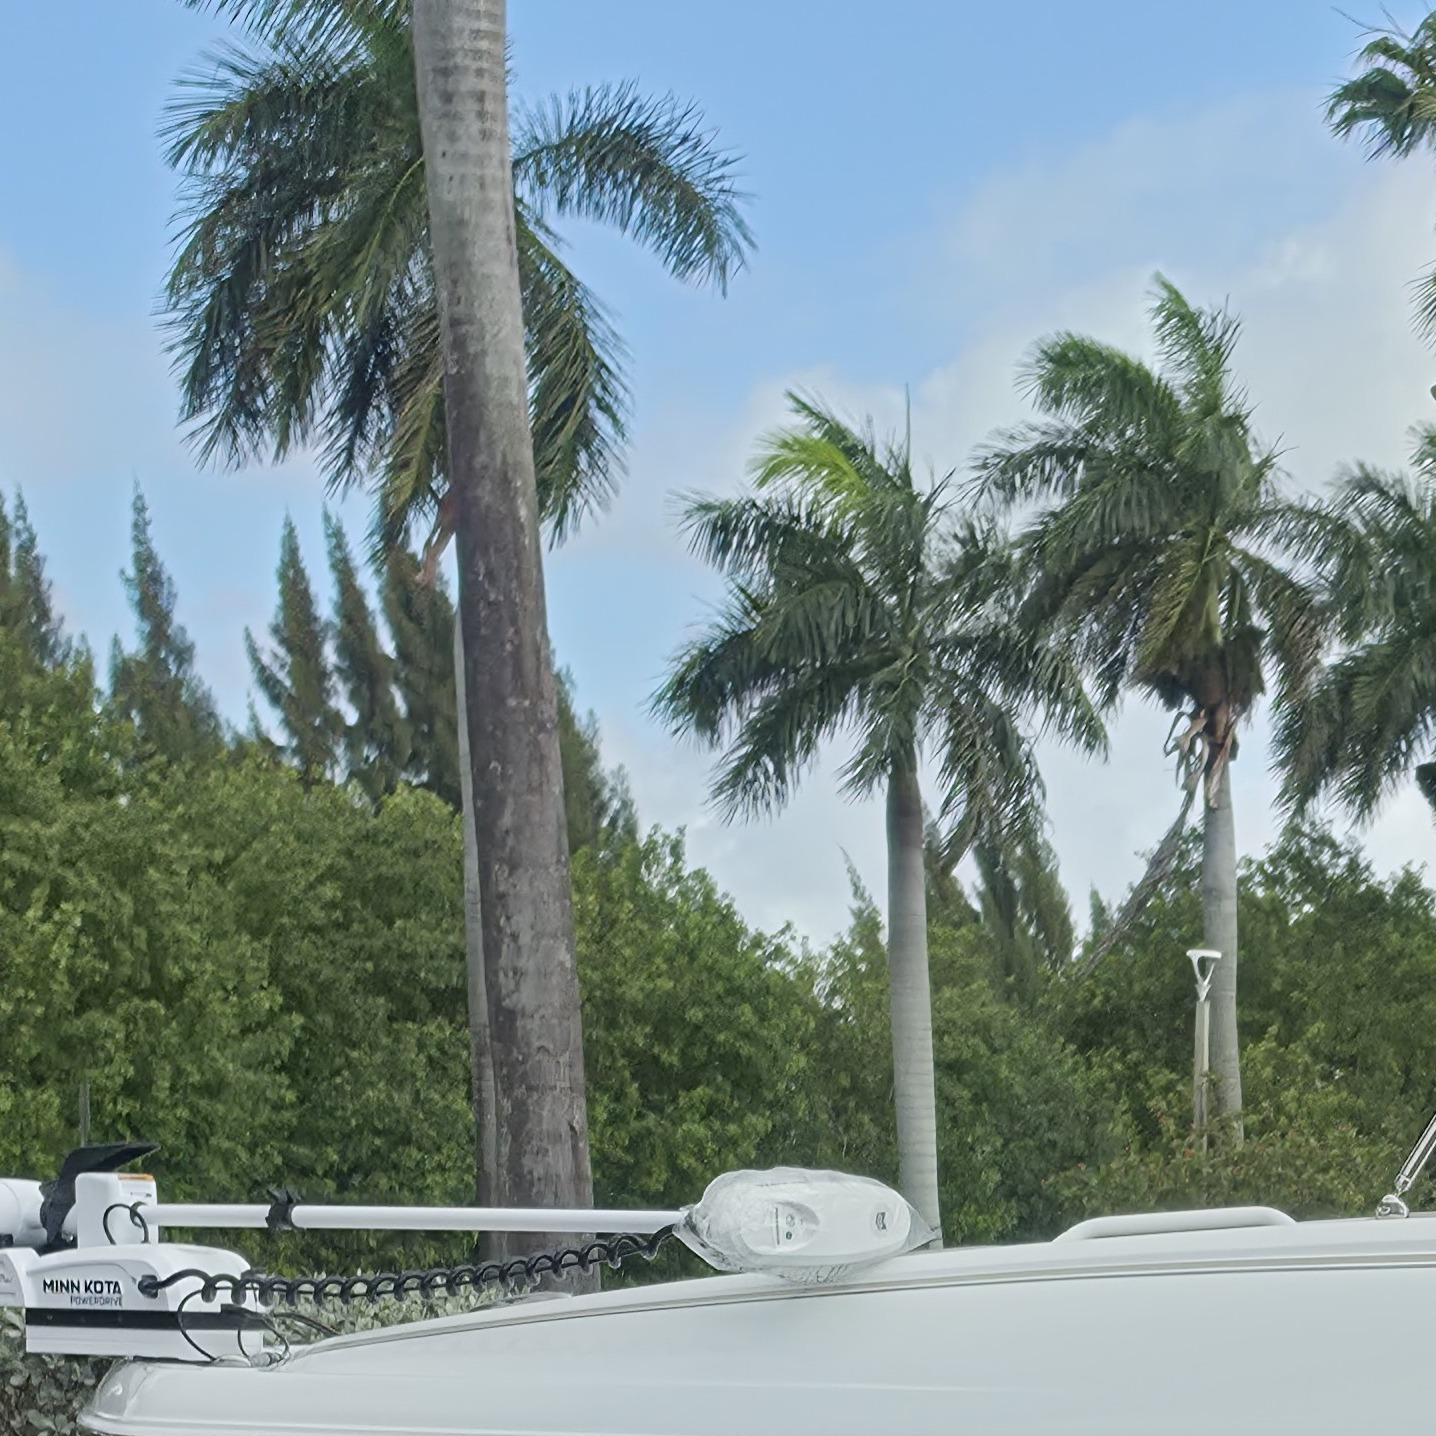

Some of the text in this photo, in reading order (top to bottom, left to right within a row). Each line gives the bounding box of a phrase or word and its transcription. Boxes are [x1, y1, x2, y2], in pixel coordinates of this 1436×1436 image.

[42, 1279, 122, 1295] MINN KOTA
[70, 1296, 122, 1306] POWERDRIVE
